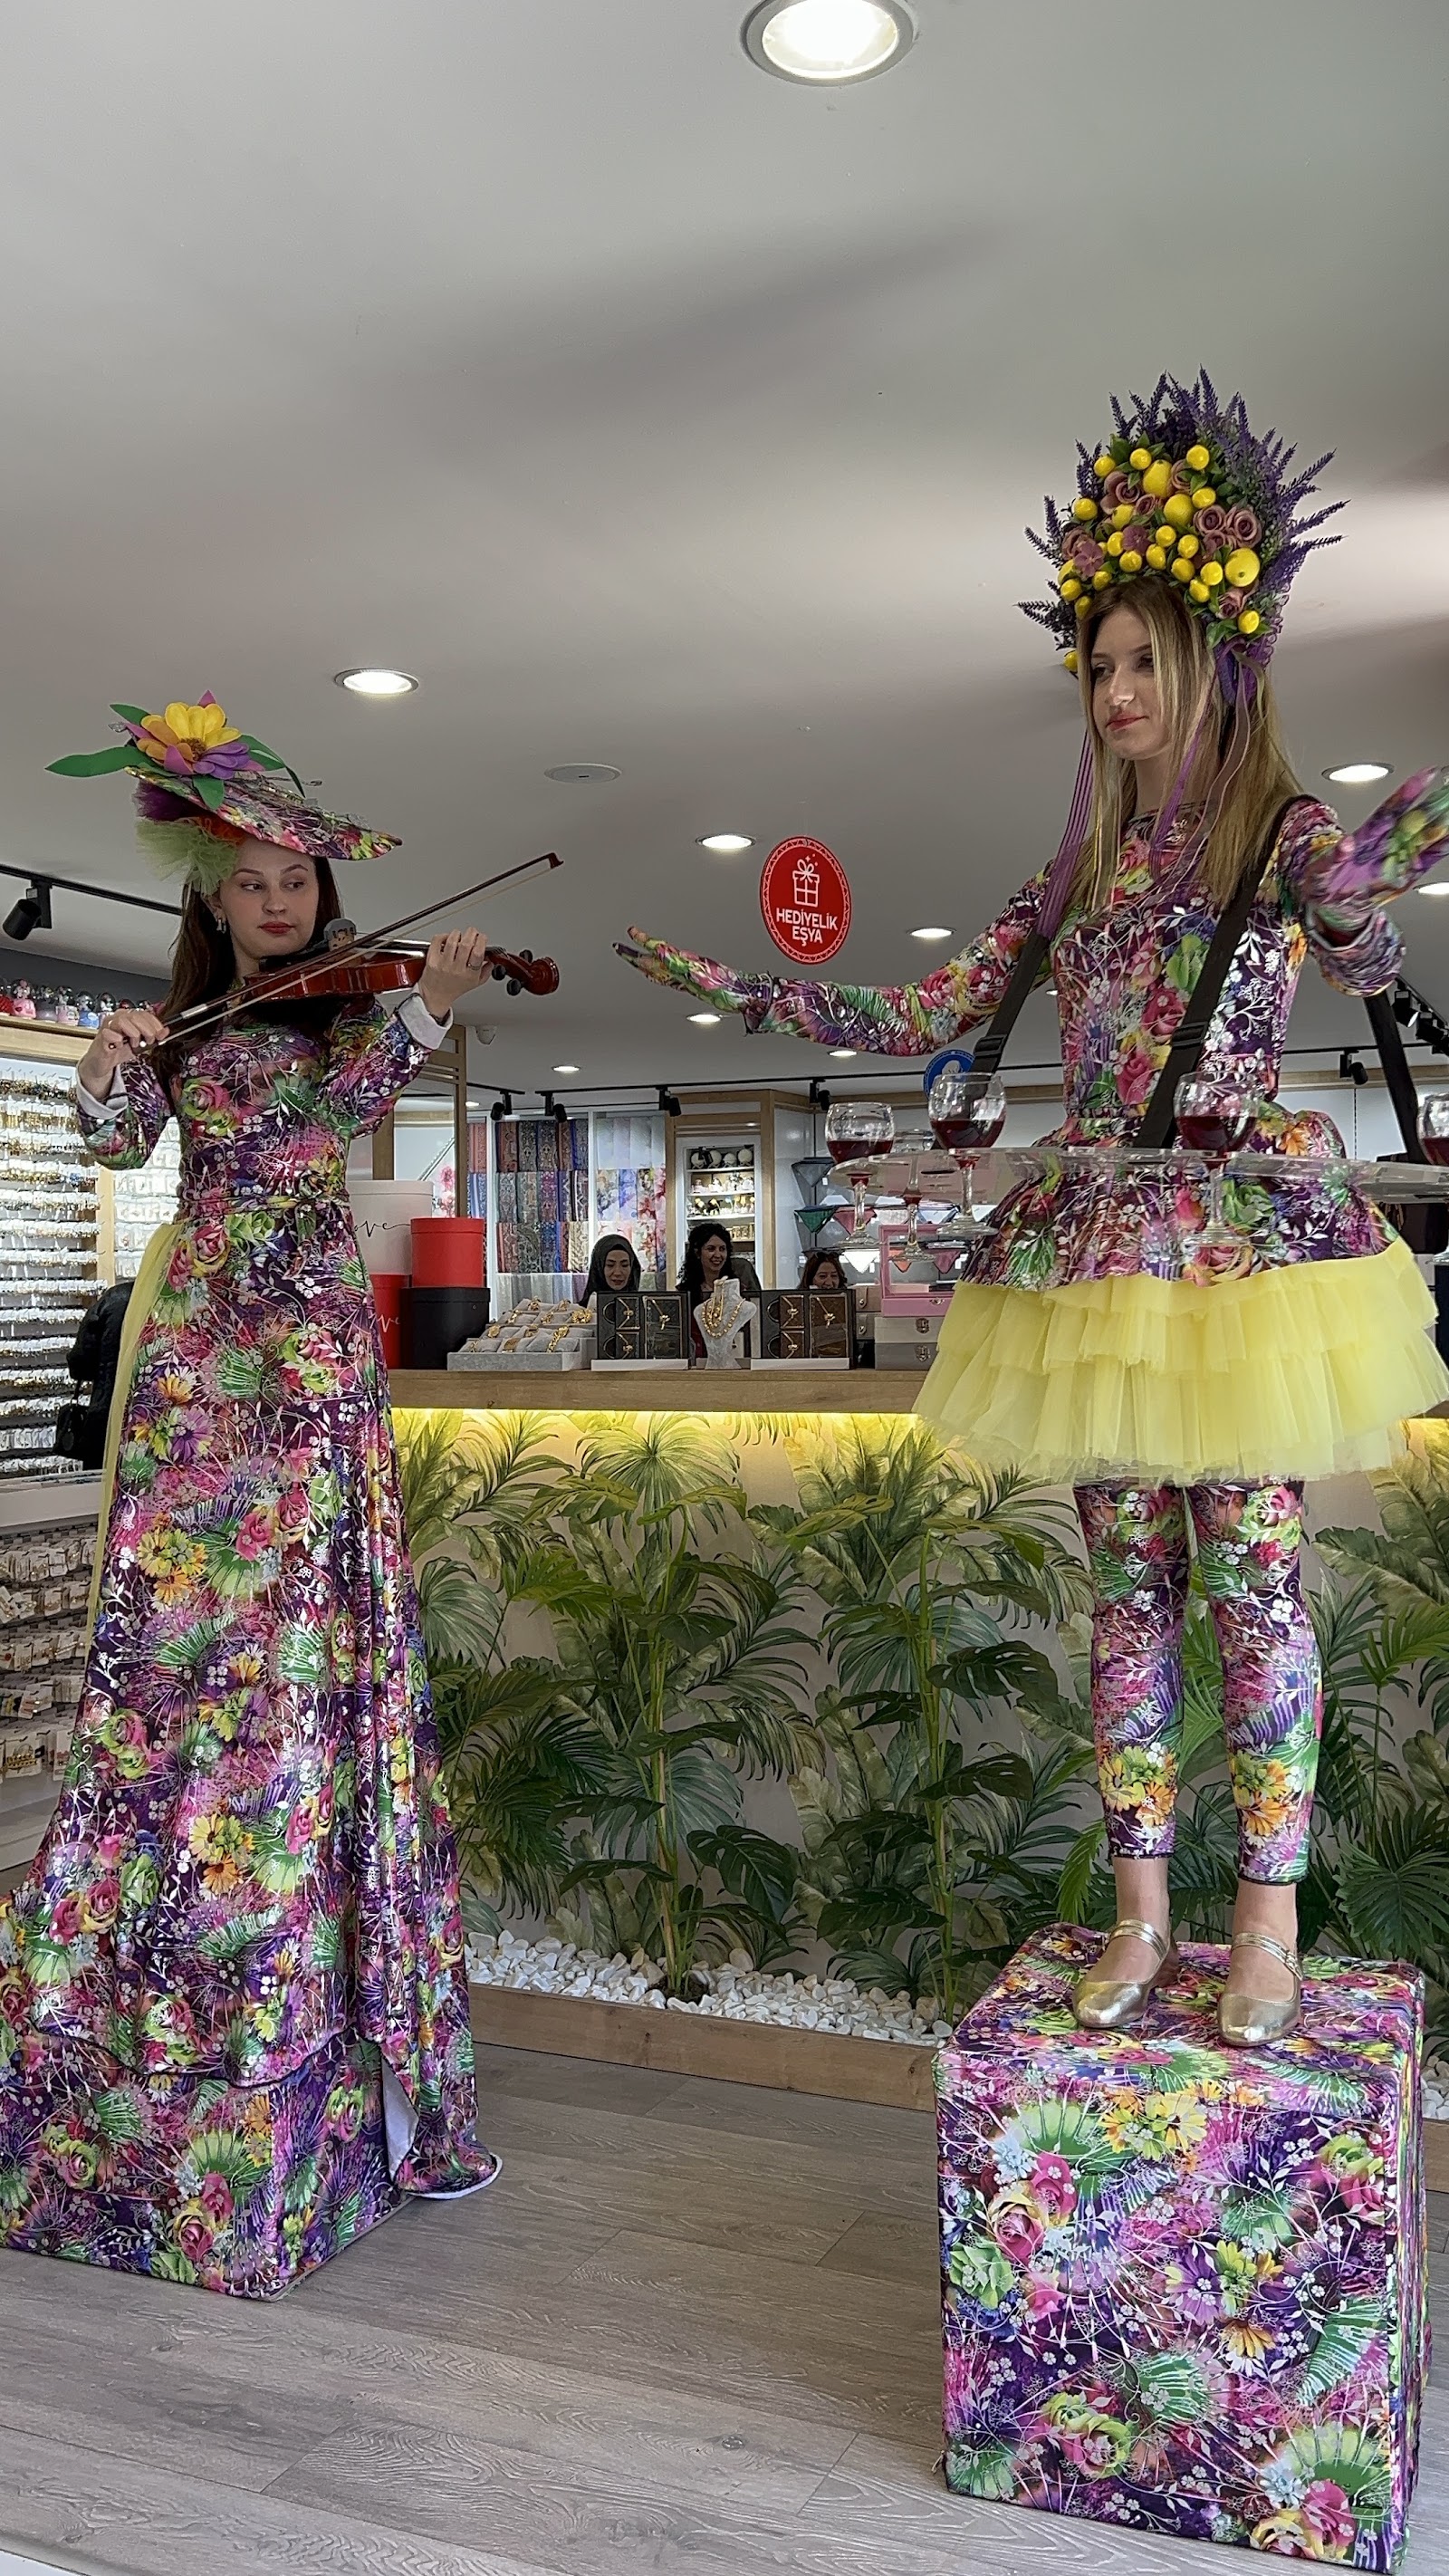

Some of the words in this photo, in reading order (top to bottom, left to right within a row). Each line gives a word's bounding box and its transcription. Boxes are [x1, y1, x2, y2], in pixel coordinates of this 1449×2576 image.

[776, 908, 838, 930] HEDİYELİK
[792, 926, 823, 947] EŞYA
[354, 1220, 410, 1237] ove
[377, 1314, 400, 1333] ve
